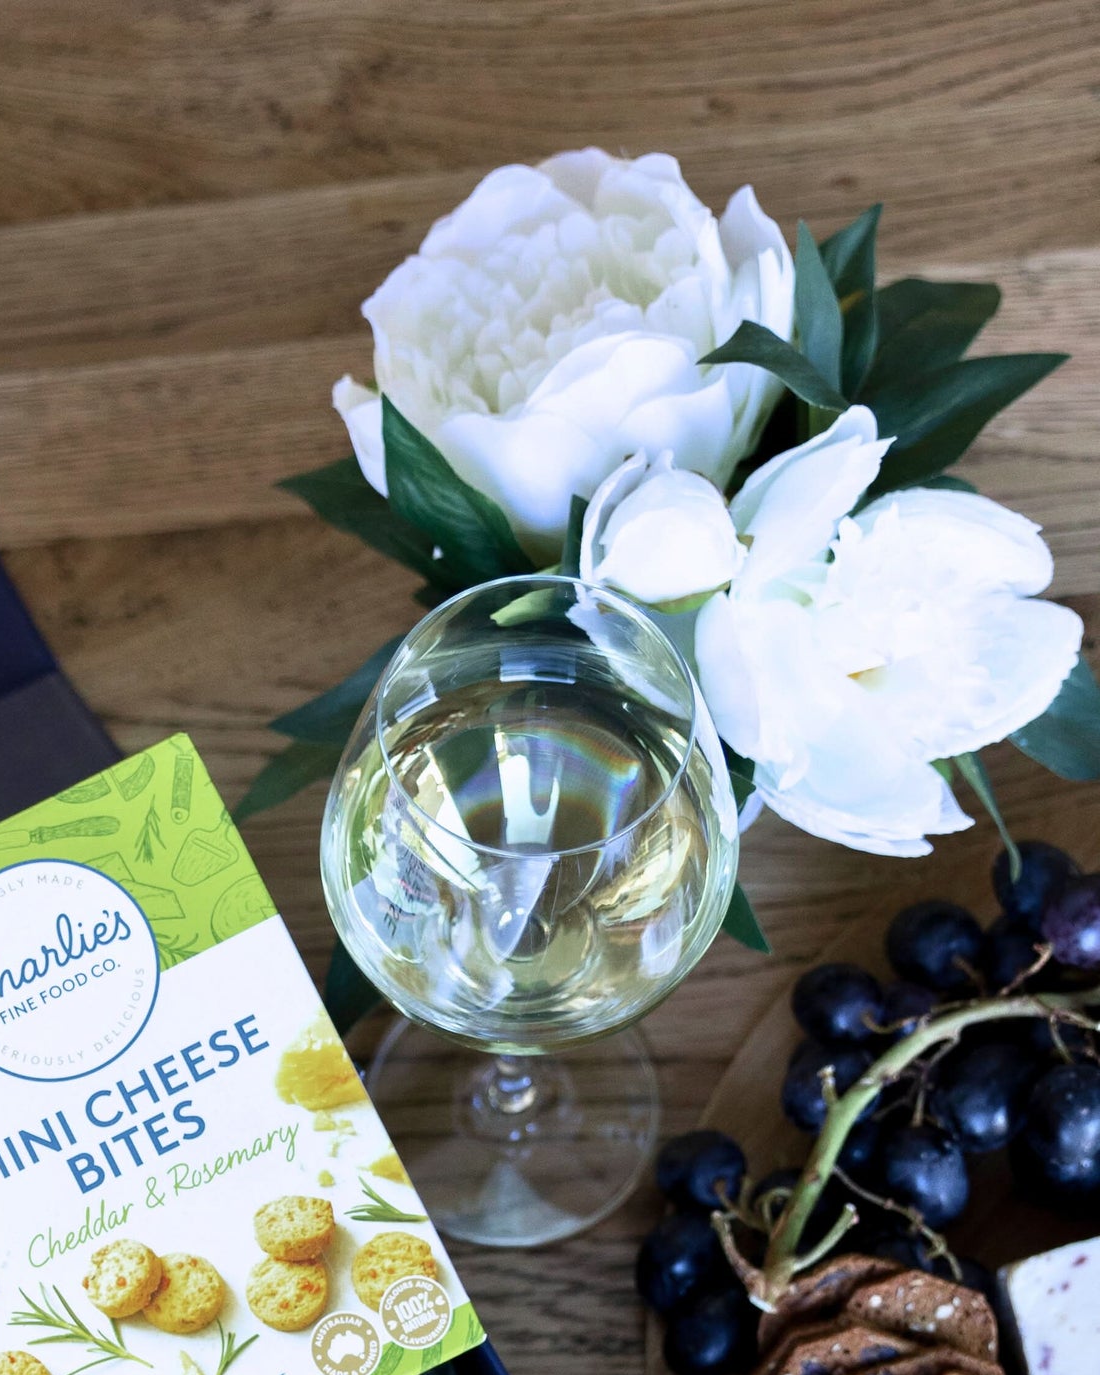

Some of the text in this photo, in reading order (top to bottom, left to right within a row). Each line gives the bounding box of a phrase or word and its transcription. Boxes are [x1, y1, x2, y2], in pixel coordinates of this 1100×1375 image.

[37, 874, 84, 890] MADE
[0, 958, 121, 1024] FINE FOOD CO.
[93, 967, 145, 1052] DELICIOUS
[85, 1014, 270, 1128] CHEESE
[66, 1098, 208, 1194] BITES
[28, 1121, 300, 1270] Cheddar & Rosemary
[384, 1280, 434, 1310] COLOURS AND
[393, 1291, 434, 1323] 100%
[315, 1316, 362, 1347] AUSTRALIAN
[399, 1313, 448, 1345] FLAVOURINGS
[401, 1309, 440, 1334] NATURAL
[359, 1340, 377, 1374] OWNED
